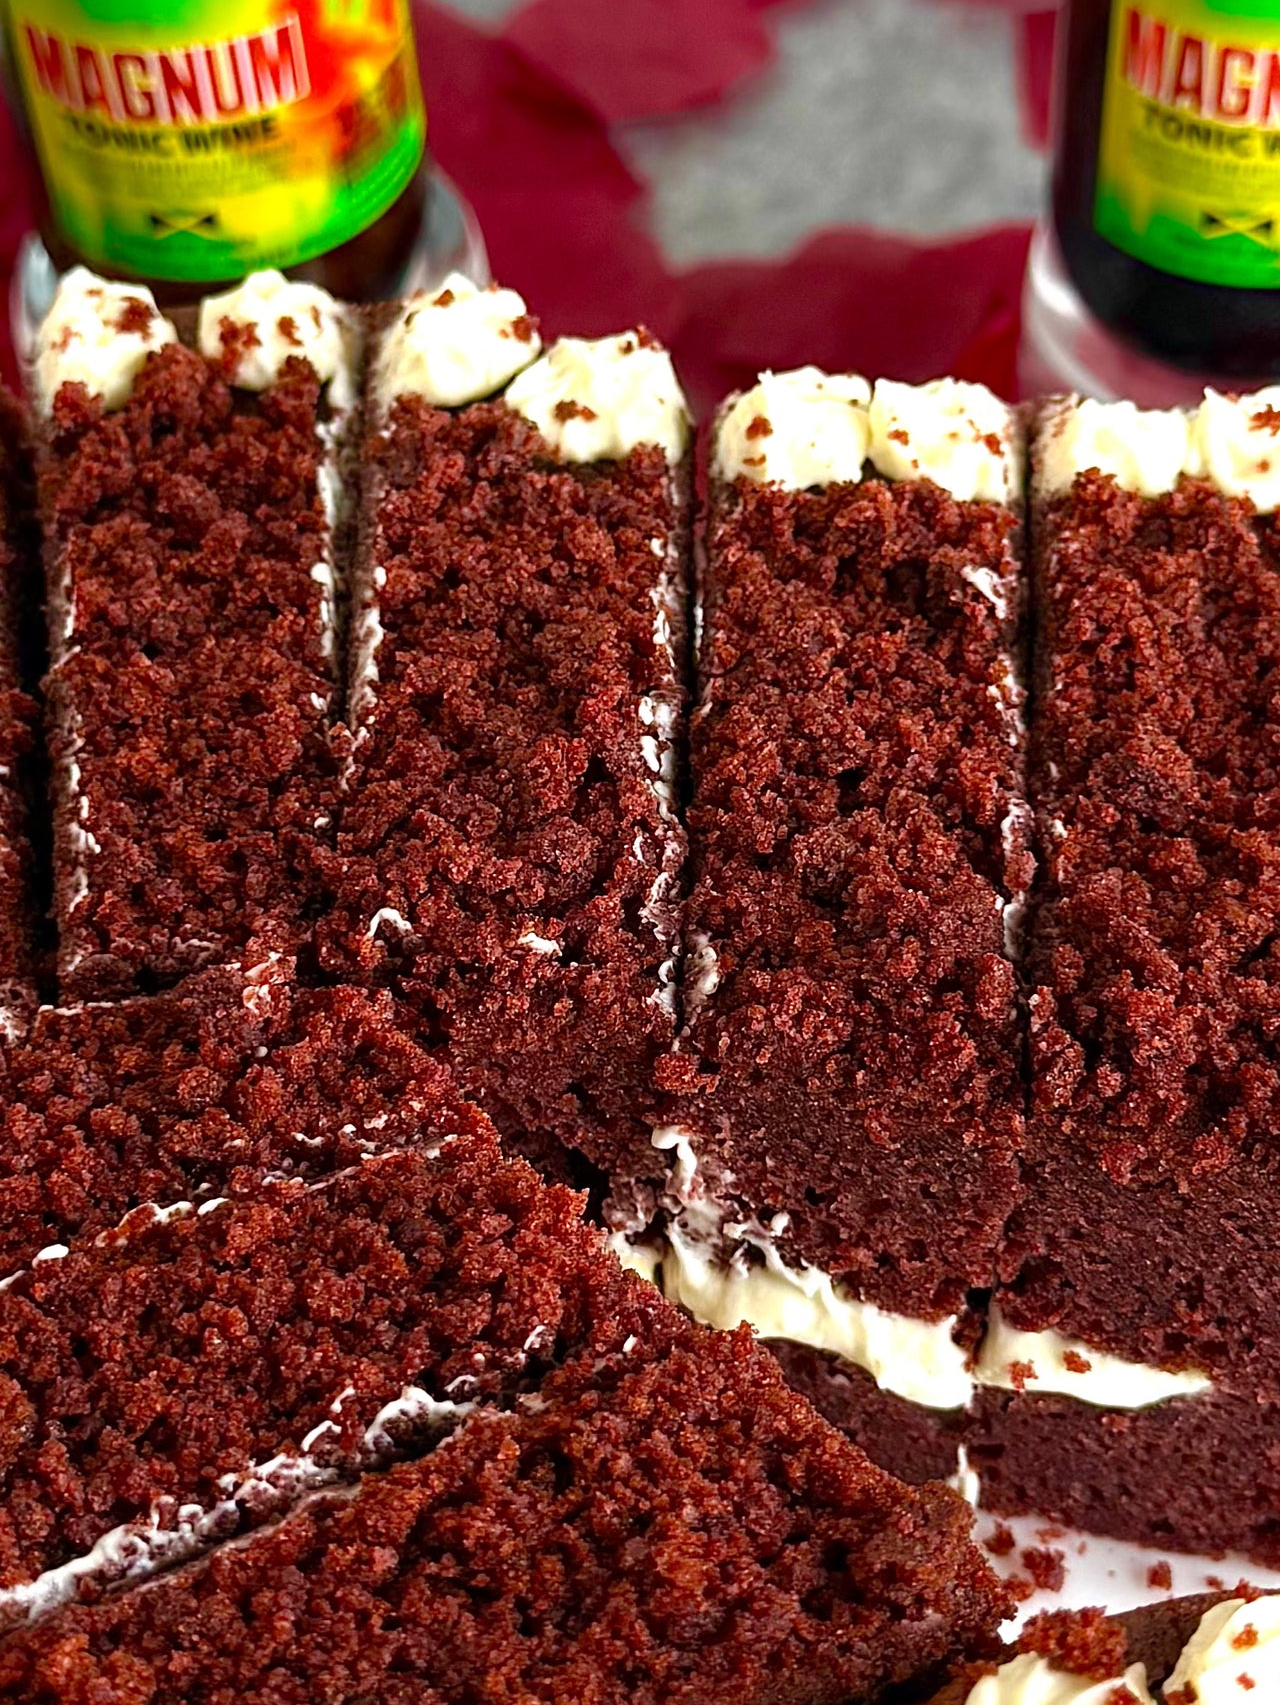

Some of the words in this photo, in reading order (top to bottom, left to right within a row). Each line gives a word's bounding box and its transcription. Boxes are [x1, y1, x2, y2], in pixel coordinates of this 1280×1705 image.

[25, 12, 311, 125] MAGNUM
[64, 114, 164, 152] TONIC
[180, 116, 278, 152] WINE
[1144, 103, 1252, 157] TONIC
